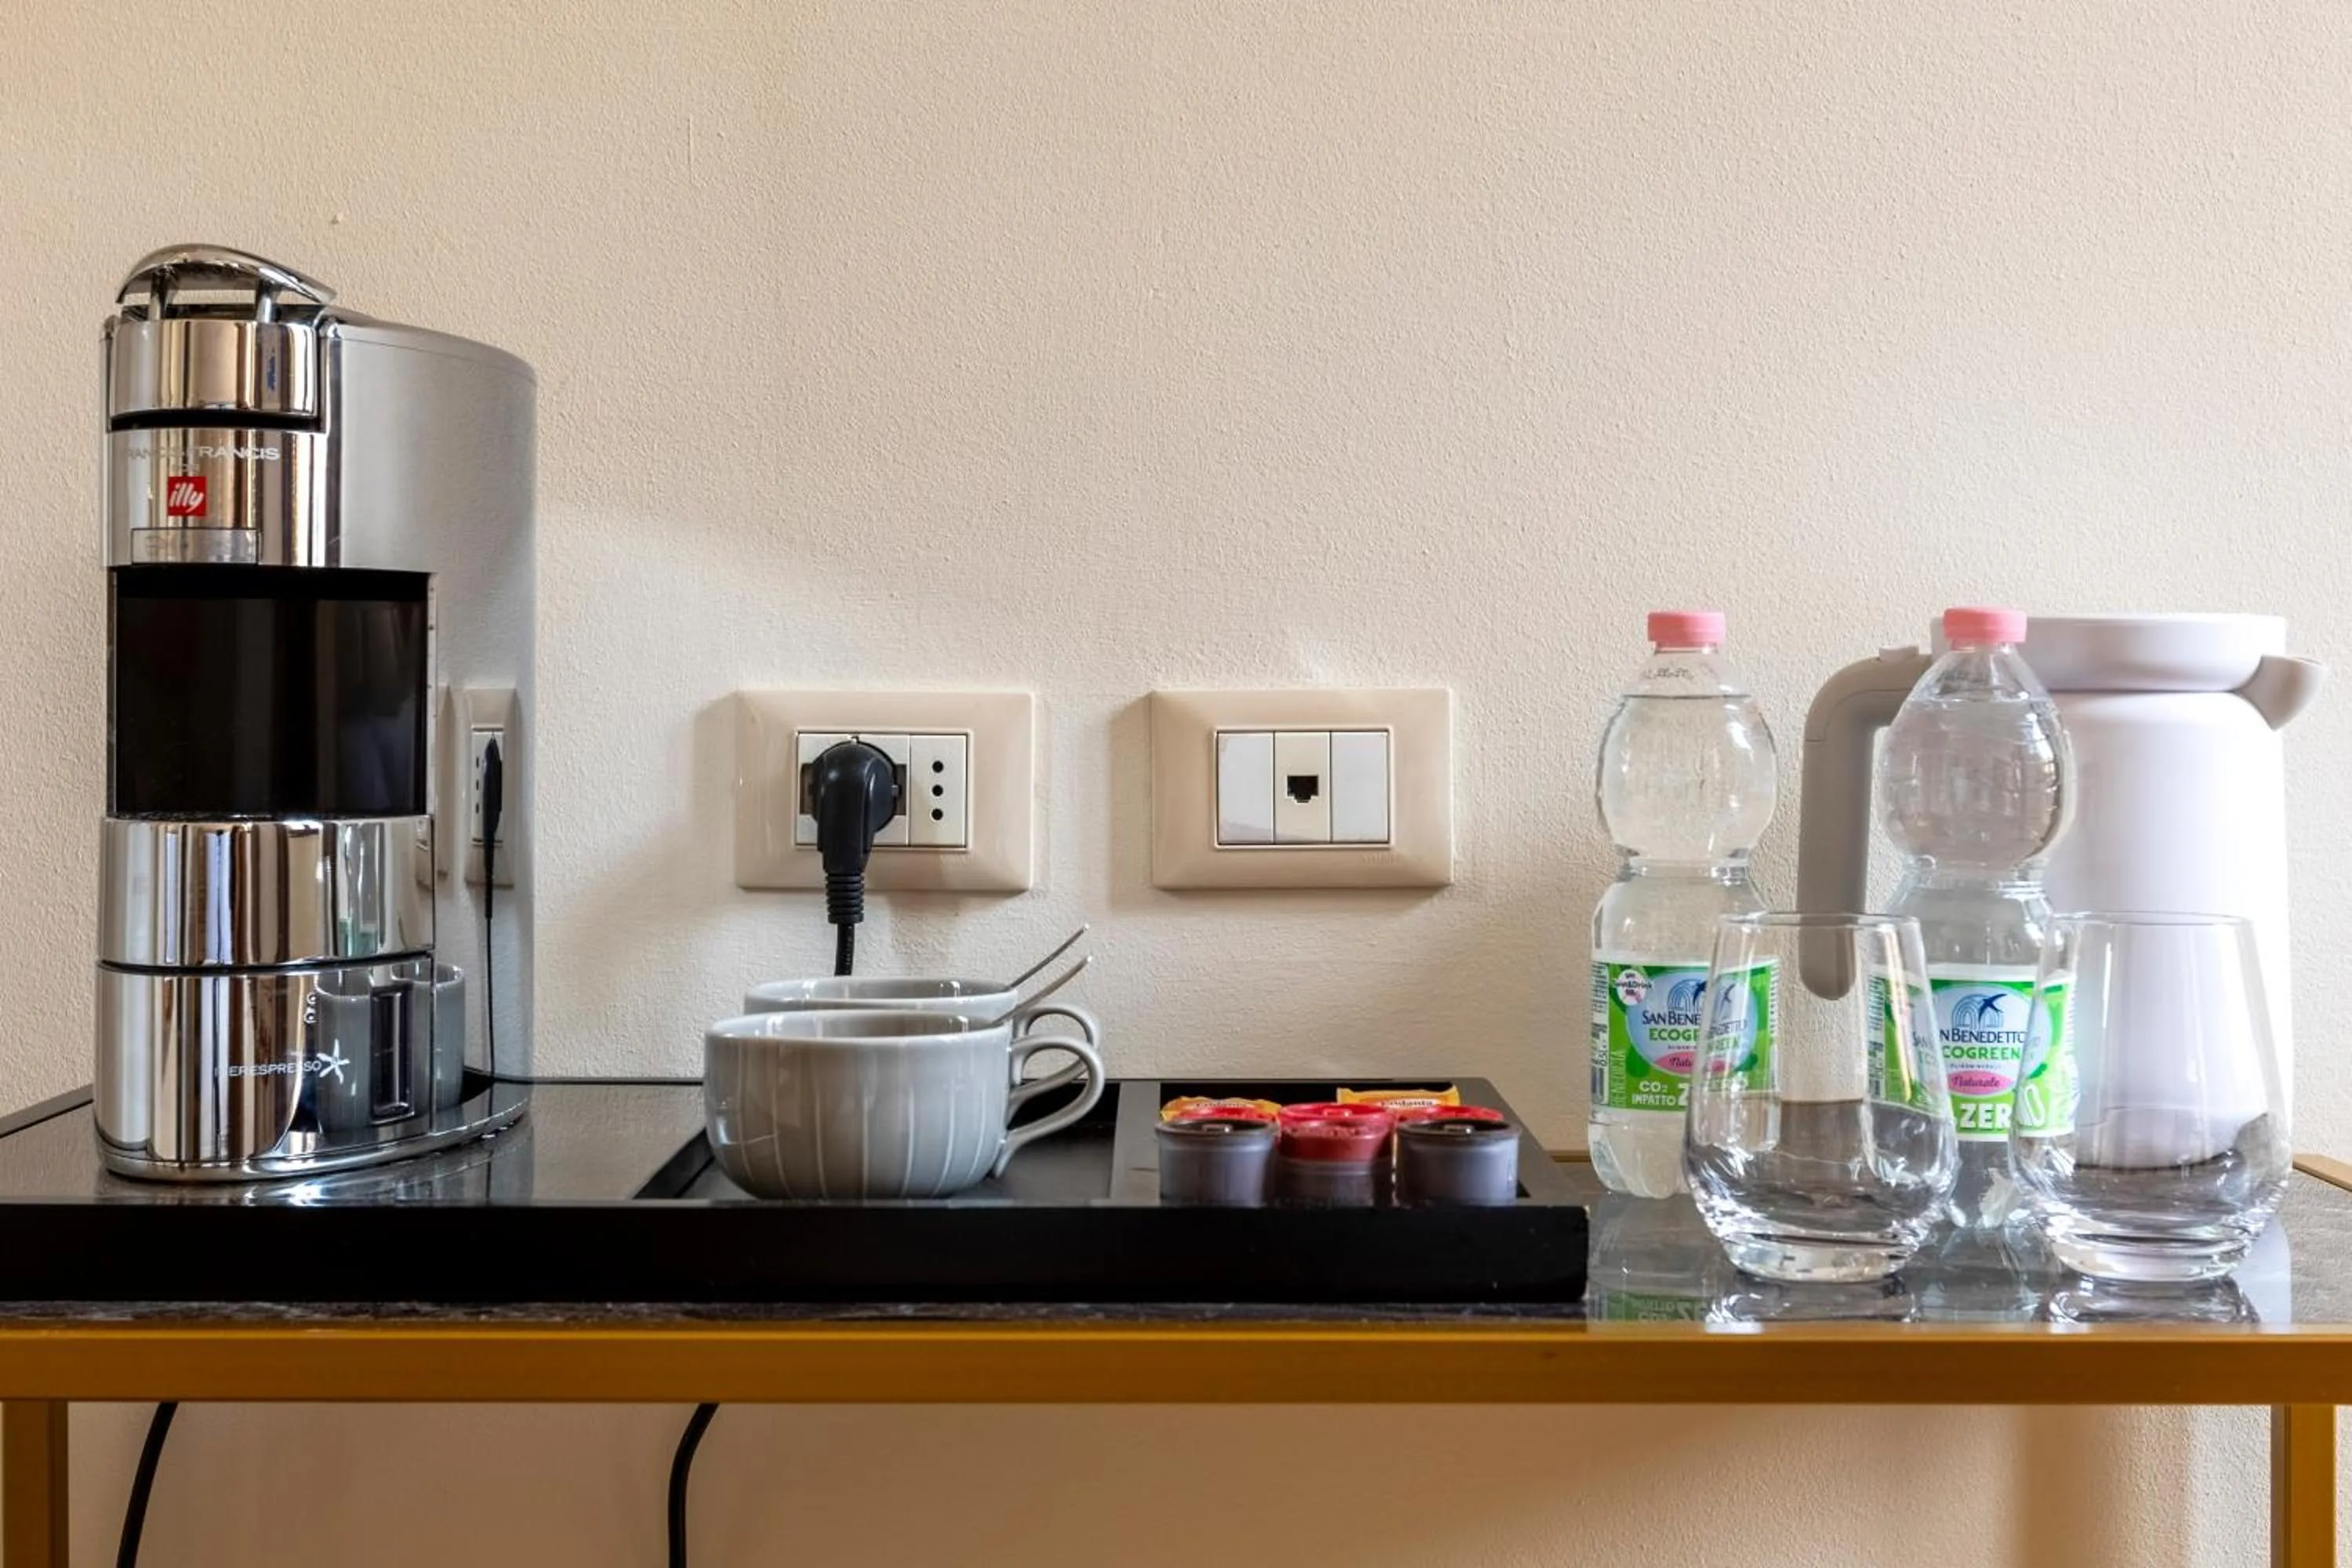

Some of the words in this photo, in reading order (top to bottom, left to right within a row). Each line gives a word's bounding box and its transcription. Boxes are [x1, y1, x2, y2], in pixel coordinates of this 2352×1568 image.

[169, 481, 205, 514] illy
[1941, 1045, 2021, 1060] COGREEN
[214, 1061, 322, 1077] IERESPRESO
[1632, 1094, 1676, 1106] IMPATTO
